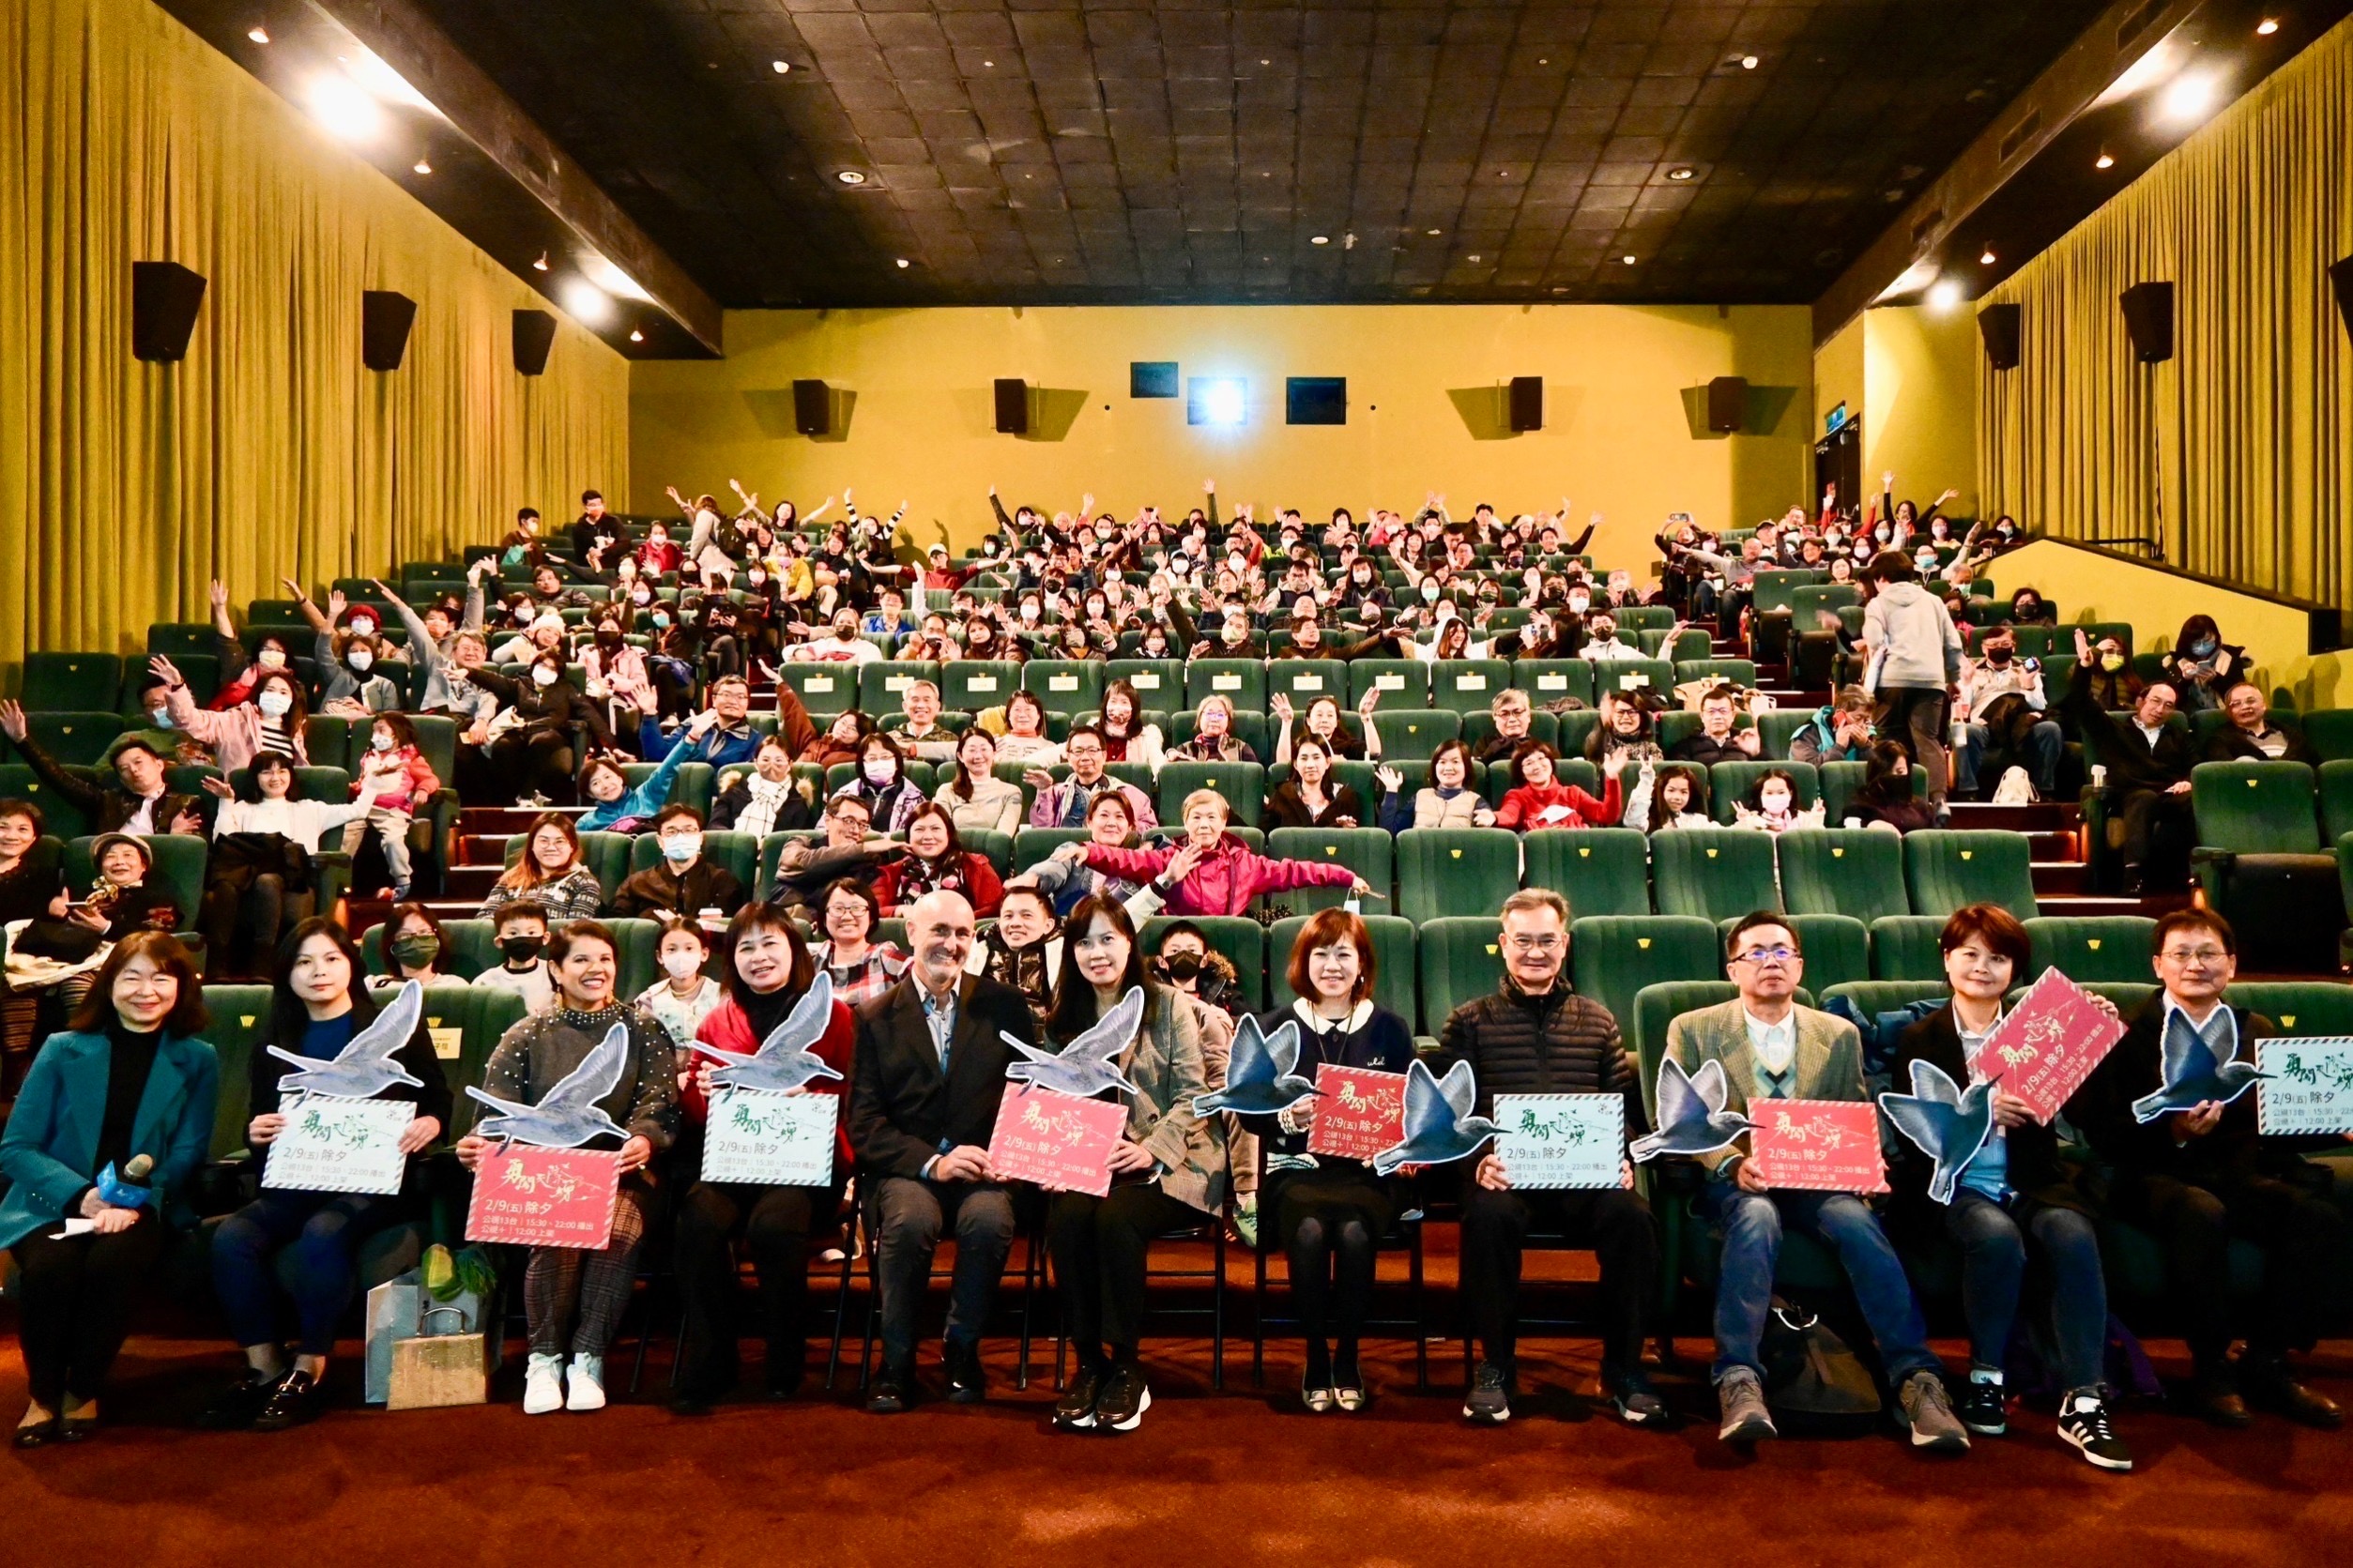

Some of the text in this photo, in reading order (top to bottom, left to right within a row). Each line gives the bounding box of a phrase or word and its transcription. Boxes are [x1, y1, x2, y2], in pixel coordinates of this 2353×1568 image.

[2021, 1043, 2065, 1096] 2/9(五) 除夕
[2061, 1067, 2078, 1087] 12:00
[2272, 1091, 2334, 1105] 2/9(五) 除夕
[1324, 1116, 1383, 1134] 2/9(五) 除夕
[718, 1140, 778, 1155] 2/9(五) 除夕
[1003, 1134, 1062, 1156] 2/9(五) 除夕
[1352, 1143, 1370, 1151] 12:00
[283, 1147, 346, 1163] 2/9(五) 除夕
[1507, 1147, 1566, 1160] 2/9(五) 除夕
[1767, 1148, 1827, 1162] 2/9(五) 除夕
[1027, 1165, 1046, 1175] 12:00
[484, 1199, 553, 1215] 2/9(五) 除夕
[515, 1227, 537, 1236] 12:00
